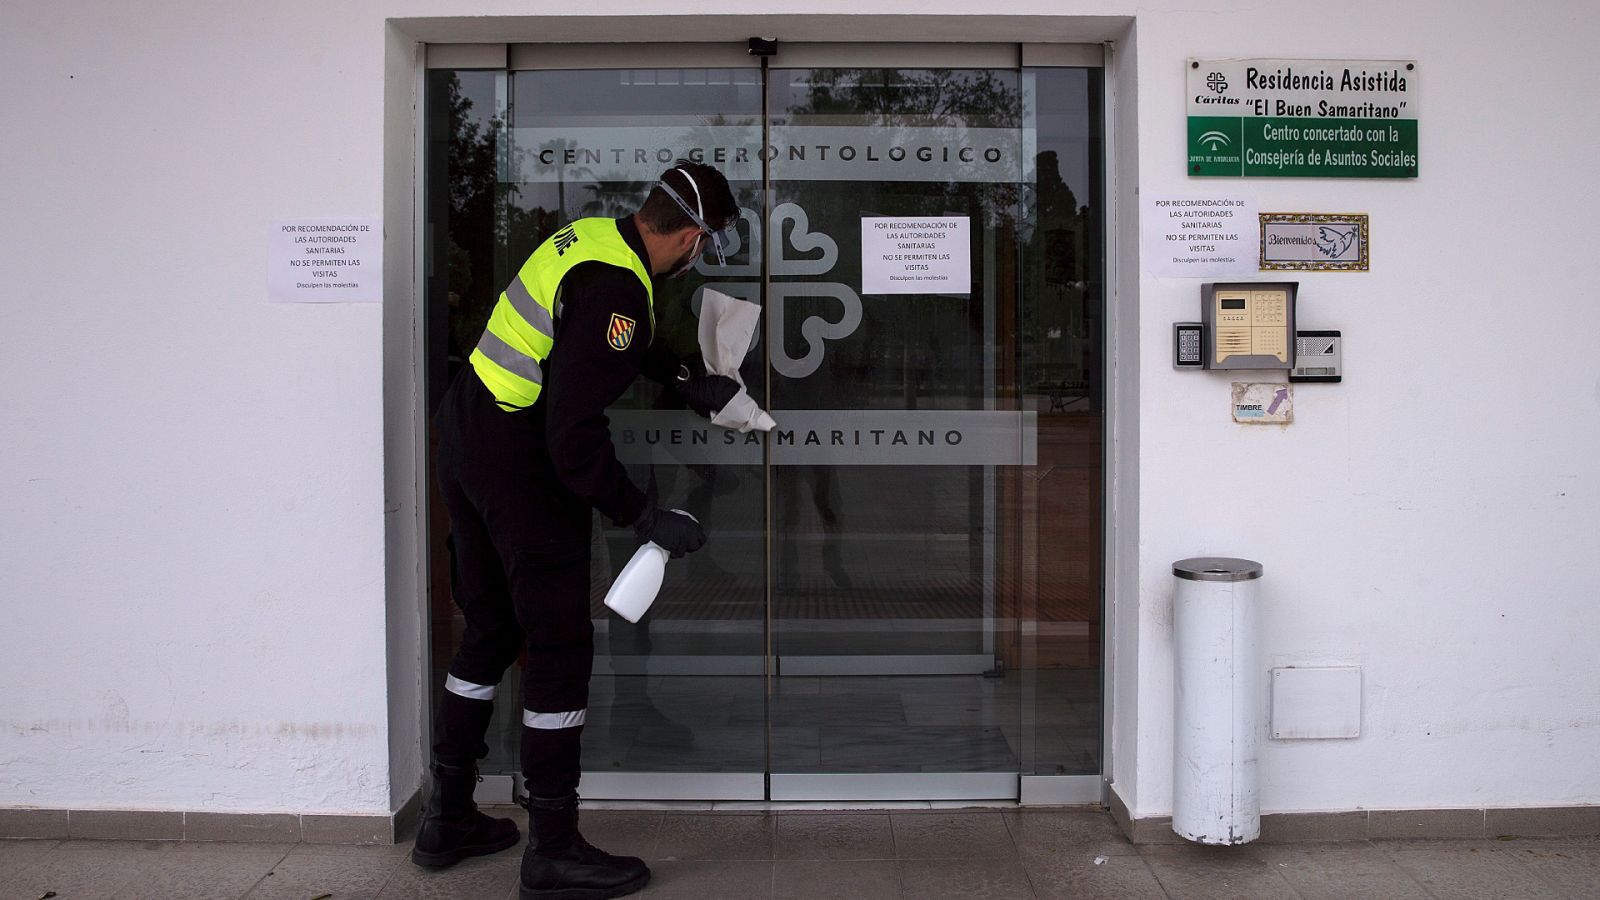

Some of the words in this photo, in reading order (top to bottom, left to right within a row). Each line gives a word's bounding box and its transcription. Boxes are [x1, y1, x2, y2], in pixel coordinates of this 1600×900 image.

[1246, 67, 1334, 91] Residencia
[1340, 69, 1407, 92] Asistida
[1195, 94, 1240, 105] Cáritas
[1276, 100, 1311, 117] Buen
[1317, 100, 1407, 118] Samaritano"
[1263, 123, 1300, 141] Centro
[1303, 125, 1362, 142] concertado
[1366, 128, 1386, 142] con
[1389, 126, 1399, 142] la
[539, 147, 674, 165] CENTRO
[688, 145, 1002, 163] GERONTOLOGICO
[1246, 148, 1304, 169] Consejería
[1308, 150, 1321, 165] de
[1324, 150, 1367, 167] Asuntos
[1371, 151, 1416, 168] Sociales
[1172, 198, 1234, 207] RECOMENDACIÓN
[298, 224, 358, 232] RECOMENDACIÓN
[889, 221, 947, 229] RECOMENDACIÓN
[1268, 233, 1317, 246] Bienvenidos
[622, 429, 709, 445] BUEN
[723, 429, 964, 446] SAMARITANO
